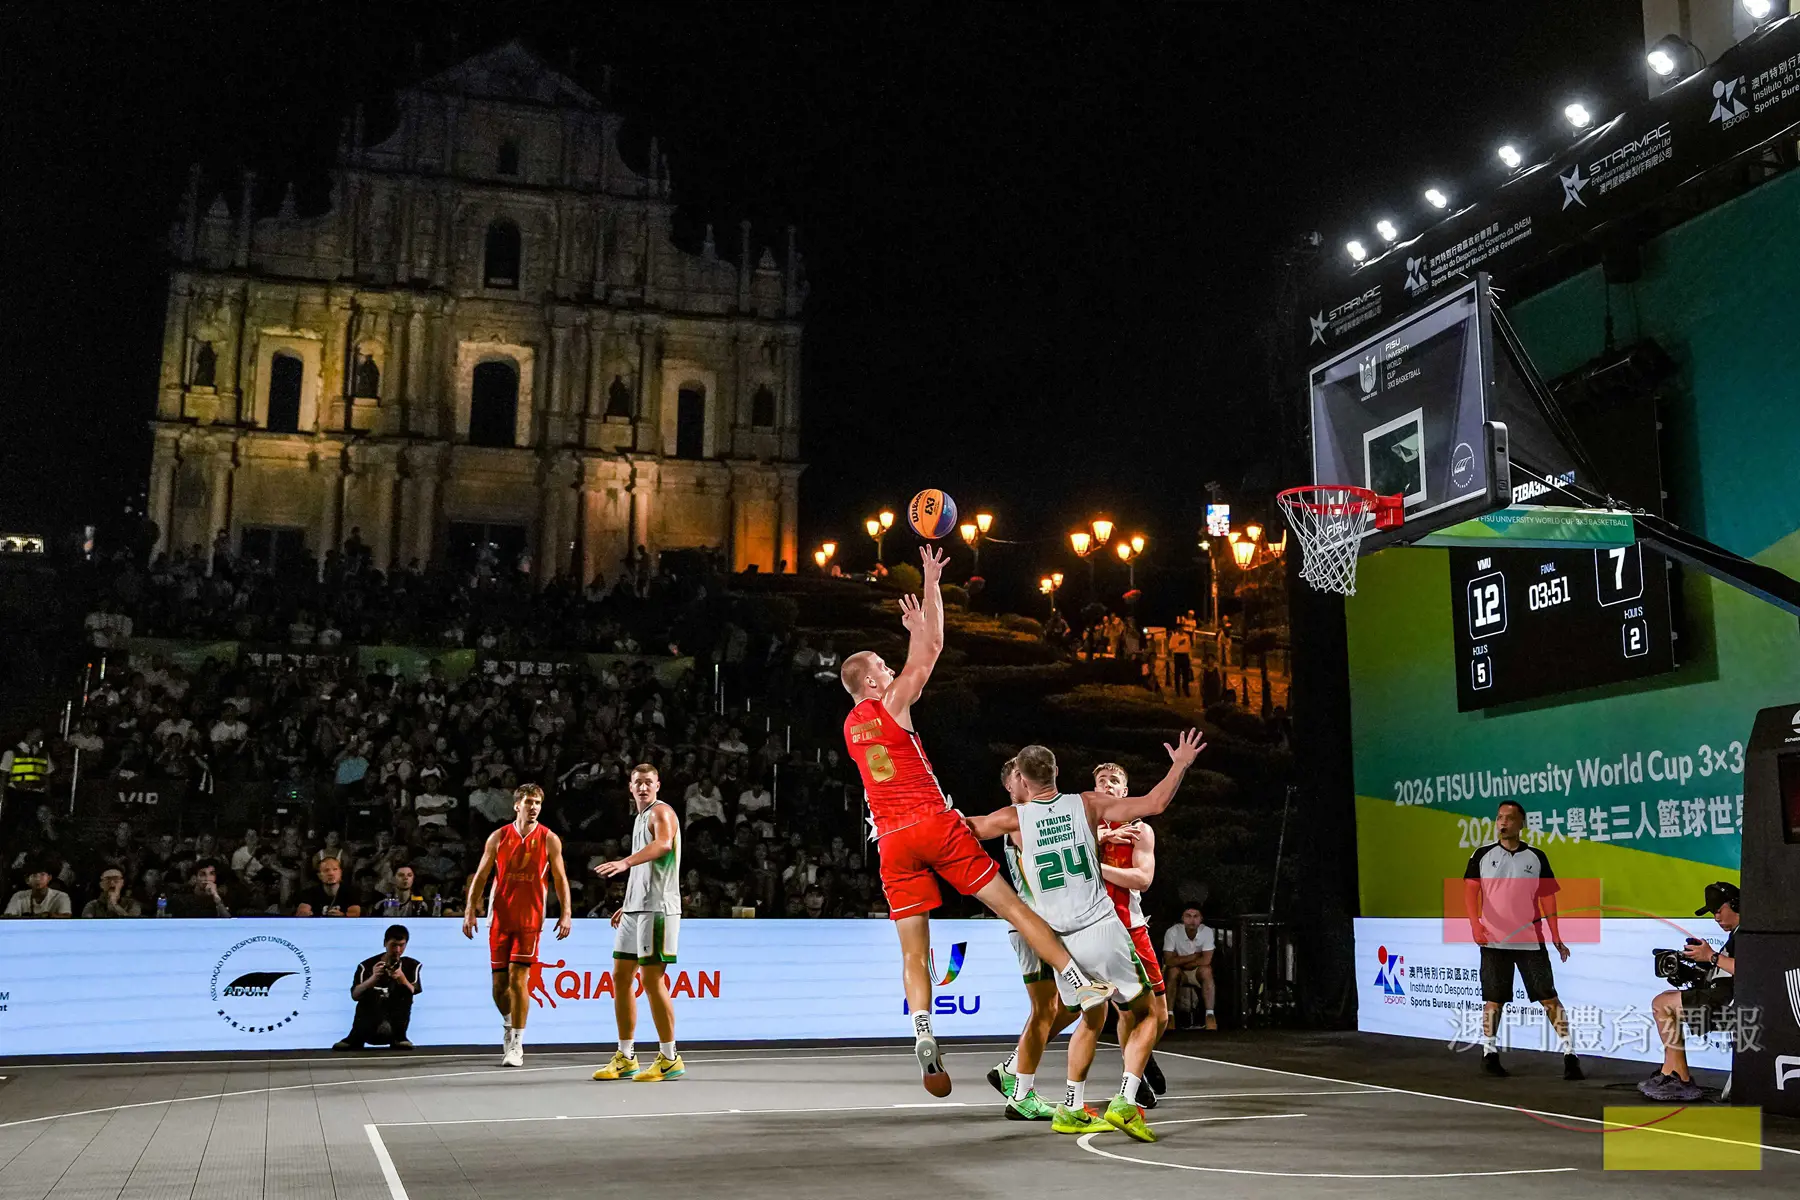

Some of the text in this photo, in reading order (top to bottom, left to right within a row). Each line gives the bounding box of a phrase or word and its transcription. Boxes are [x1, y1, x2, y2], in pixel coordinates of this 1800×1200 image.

[1753, 80, 1782, 101] Instituto
[1784, 73, 1793, 84] do
[1754, 95, 1779, 113] Sports
[1589, 121, 1671, 176] STARMAC
[1592, 160, 1629, 186] Entertainment
[1630, 143, 1660, 165] Production
[1456, 247, 1477, 264] Desporto
[1485, 233, 1506, 248] Governo
[1507, 227, 1514, 236] da
[1514, 216, 1531, 231] RAEM
[1431, 275, 1447, 287] Sports
[1488, 245, 1500, 256] SAR
[1500, 228, 1532, 249] Government
[1386, 338, 1401, 352] FISU
[1386, 344, 1410, 361] UNIVERSITY
[1386, 358, 1402, 370] WORLD
[1387, 370, 1396, 380] CUP
[1396, 368, 1421, 386] BASKETBALL
[1496, 516, 1535, 525] UNIVERSITY
[1536, 517, 1560, 526] WORLD
[1588, 518, 1628, 527] BASKETBALL
[1477, 557, 1492, 571] VMU
[1540, 562, 1556, 575] FINAL
[1609, 547, 1626, 590] 7
[1529, 576, 1571, 611] 03:51
[1473, 583, 1501, 627] 12
[1630, 627, 1641, 650] 2
[1477, 663, 1486, 683] 5
[1394, 778, 1434, 807] 2026
[1437, 772, 1475, 803] FISU
[1478, 763, 1573, 797] University
[1577, 752, 1643, 788] World
[1647, 750, 1694, 785] Cup
[1036, 814, 1072, 828] VYTAUTAS
[1037, 832, 1076, 847] UNIVERSIT
[1039, 823, 1071, 838] MAGNUS
[1033, 842, 1094, 893] 24
[221, 951, 232, 961] DO
[231, 935, 267, 952] DESPORTO
[1408, 966, 1480, 982] 澳門特別行政區政府
[223, 986, 269, 997] ADUM
[1409, 982, 1434, 995] Instituto
[1435, 984, 1443, 995] do
[1444, 985, 1473, 999] Desporto
[1516, 988, 1525, 999] da
[1410, 996, 1431, 1009] Sports
[1433, 998, 1456, 1010] Bureau
[1457, 1000, 1464, 1010] of
[1506, 1003, 1546, 1017] Governme
